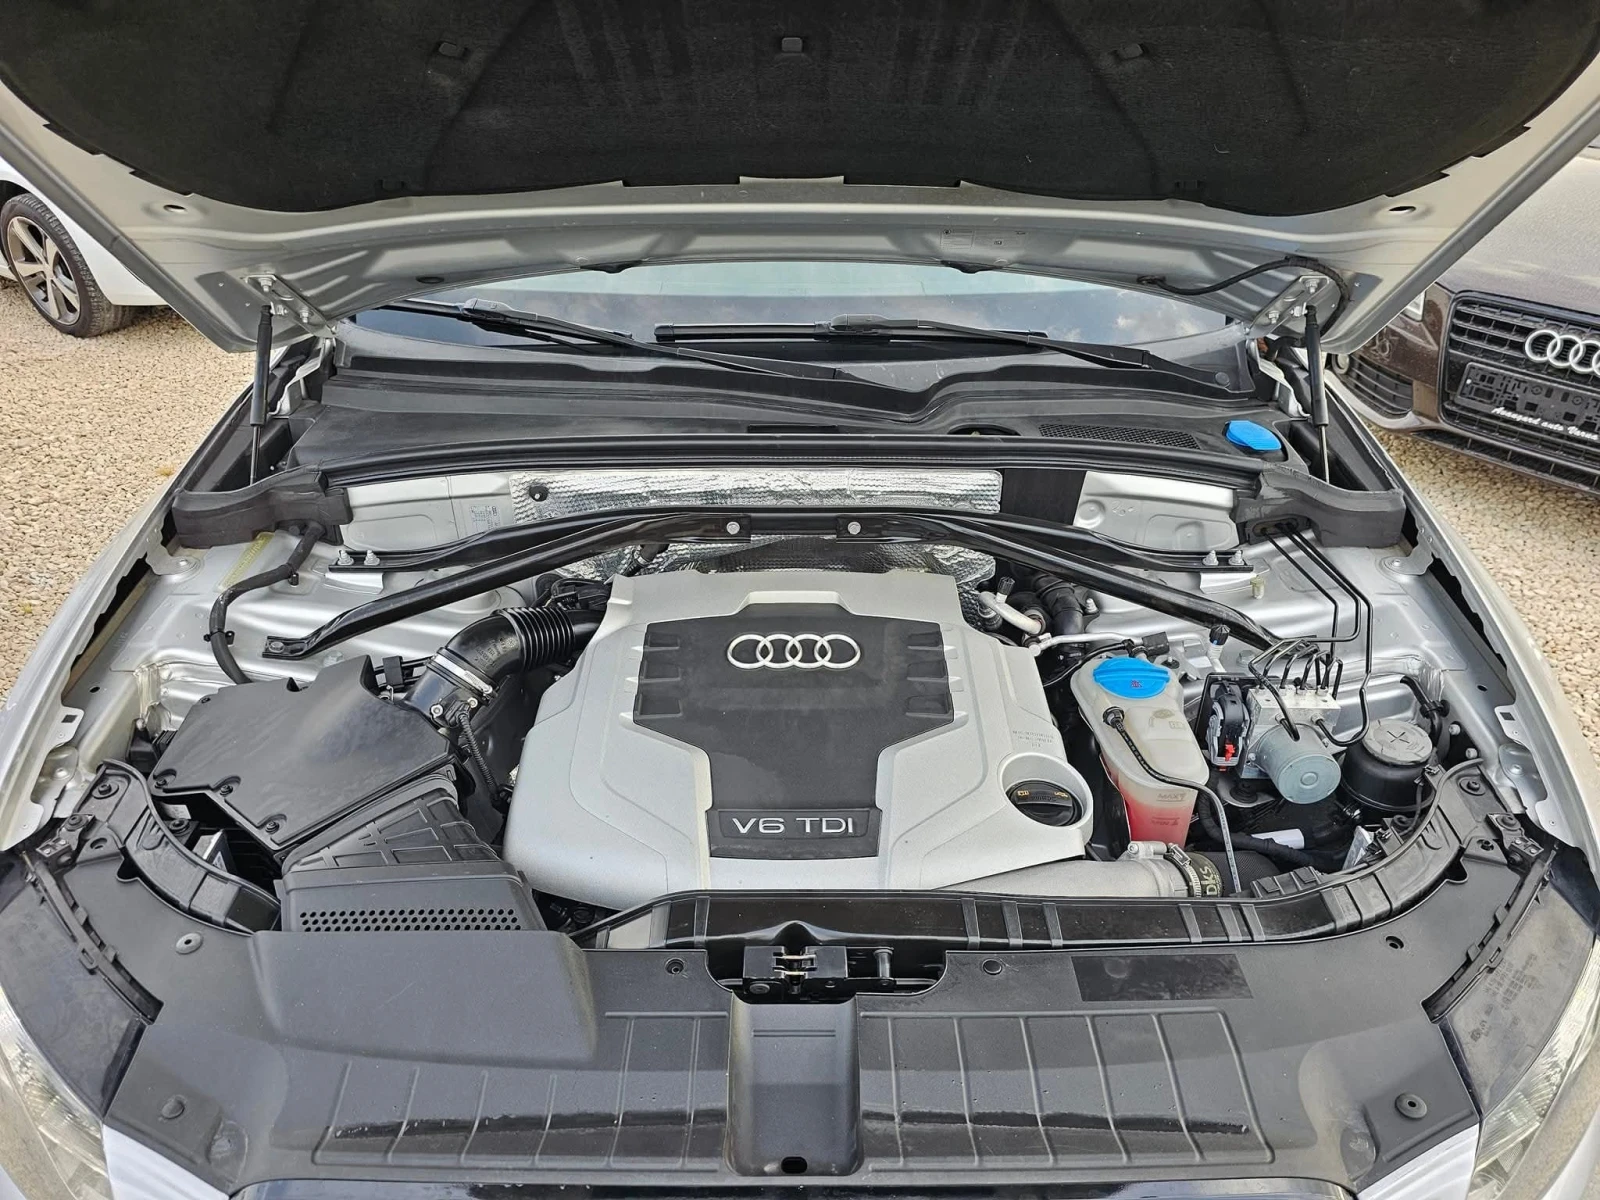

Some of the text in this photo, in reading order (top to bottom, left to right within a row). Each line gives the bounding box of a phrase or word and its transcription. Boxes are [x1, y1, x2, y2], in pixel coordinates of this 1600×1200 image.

[1541, 421, 1564, 431] auto
[1567, 426, 1599, 440] Varna
[732, 817, 854, 834] V6 TDI
